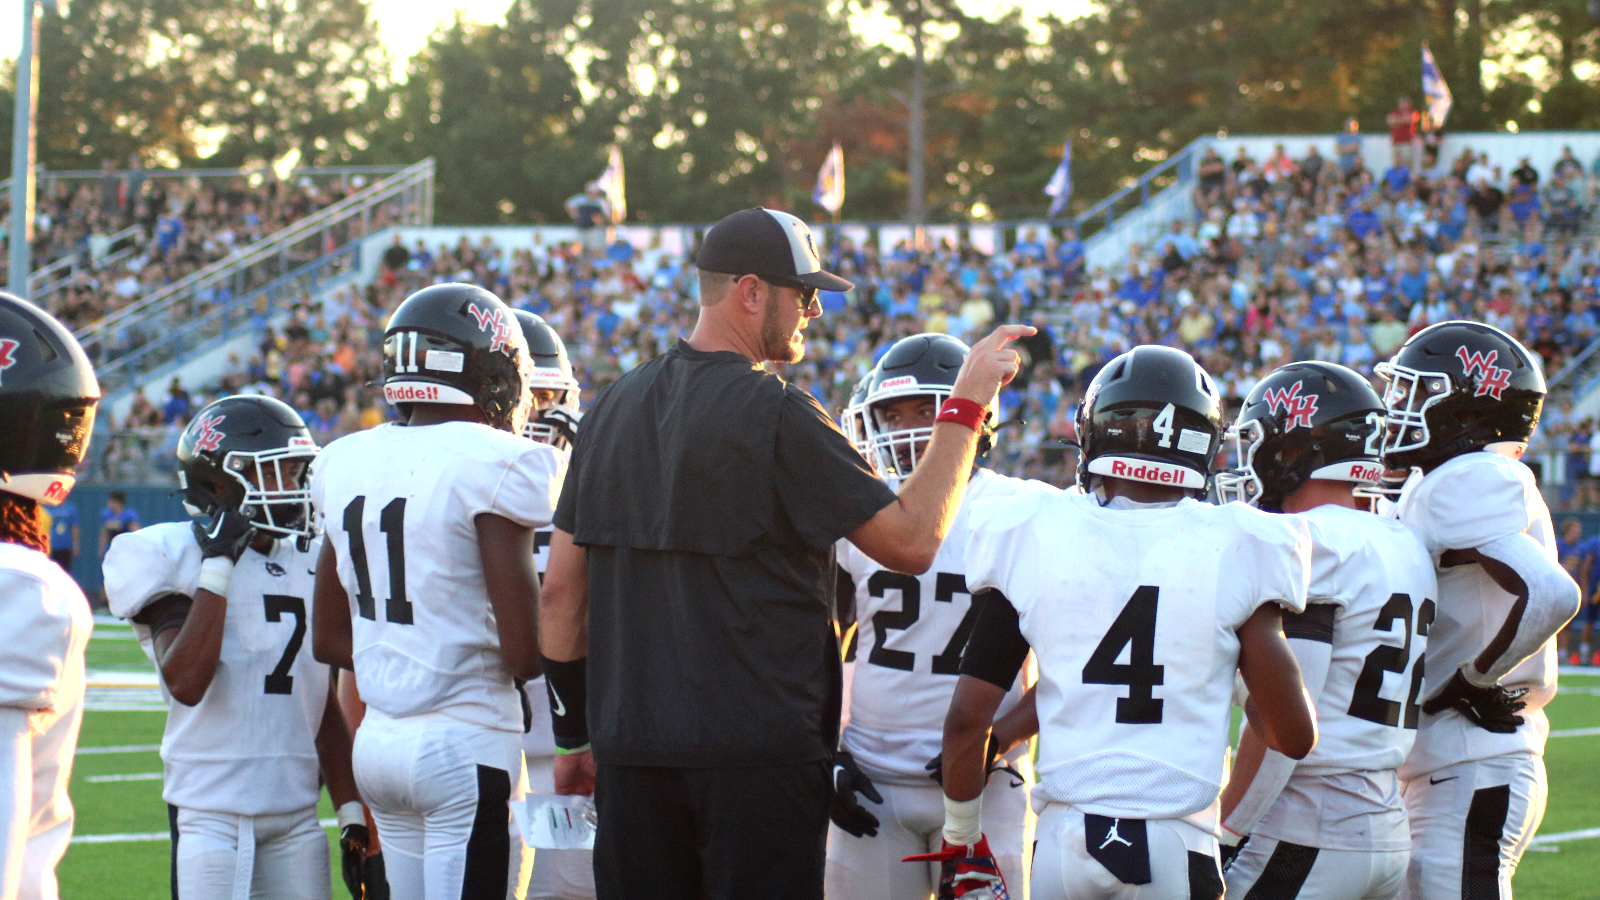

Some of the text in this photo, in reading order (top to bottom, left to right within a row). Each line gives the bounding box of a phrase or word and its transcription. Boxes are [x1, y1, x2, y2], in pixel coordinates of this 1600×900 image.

[395, 331, 419, 373] 11
[1456, 345, 1512, 401] WH
[386, 386, 439, 400] Riddell
[881, 377, 911, 388] Riddell
[1263, 380, 1319, 433] WH
[1152, 402, 1174, 449] 4
[1111, 459, 1186, 485] Riddell
[1349, 464, 1382, 482] Ridd
[343, 495, 414, 625] 11
[263, 594, 307, 695] 7
[867, 569, 978, 676] 27
[1081, 585, 1165, 724] 4
